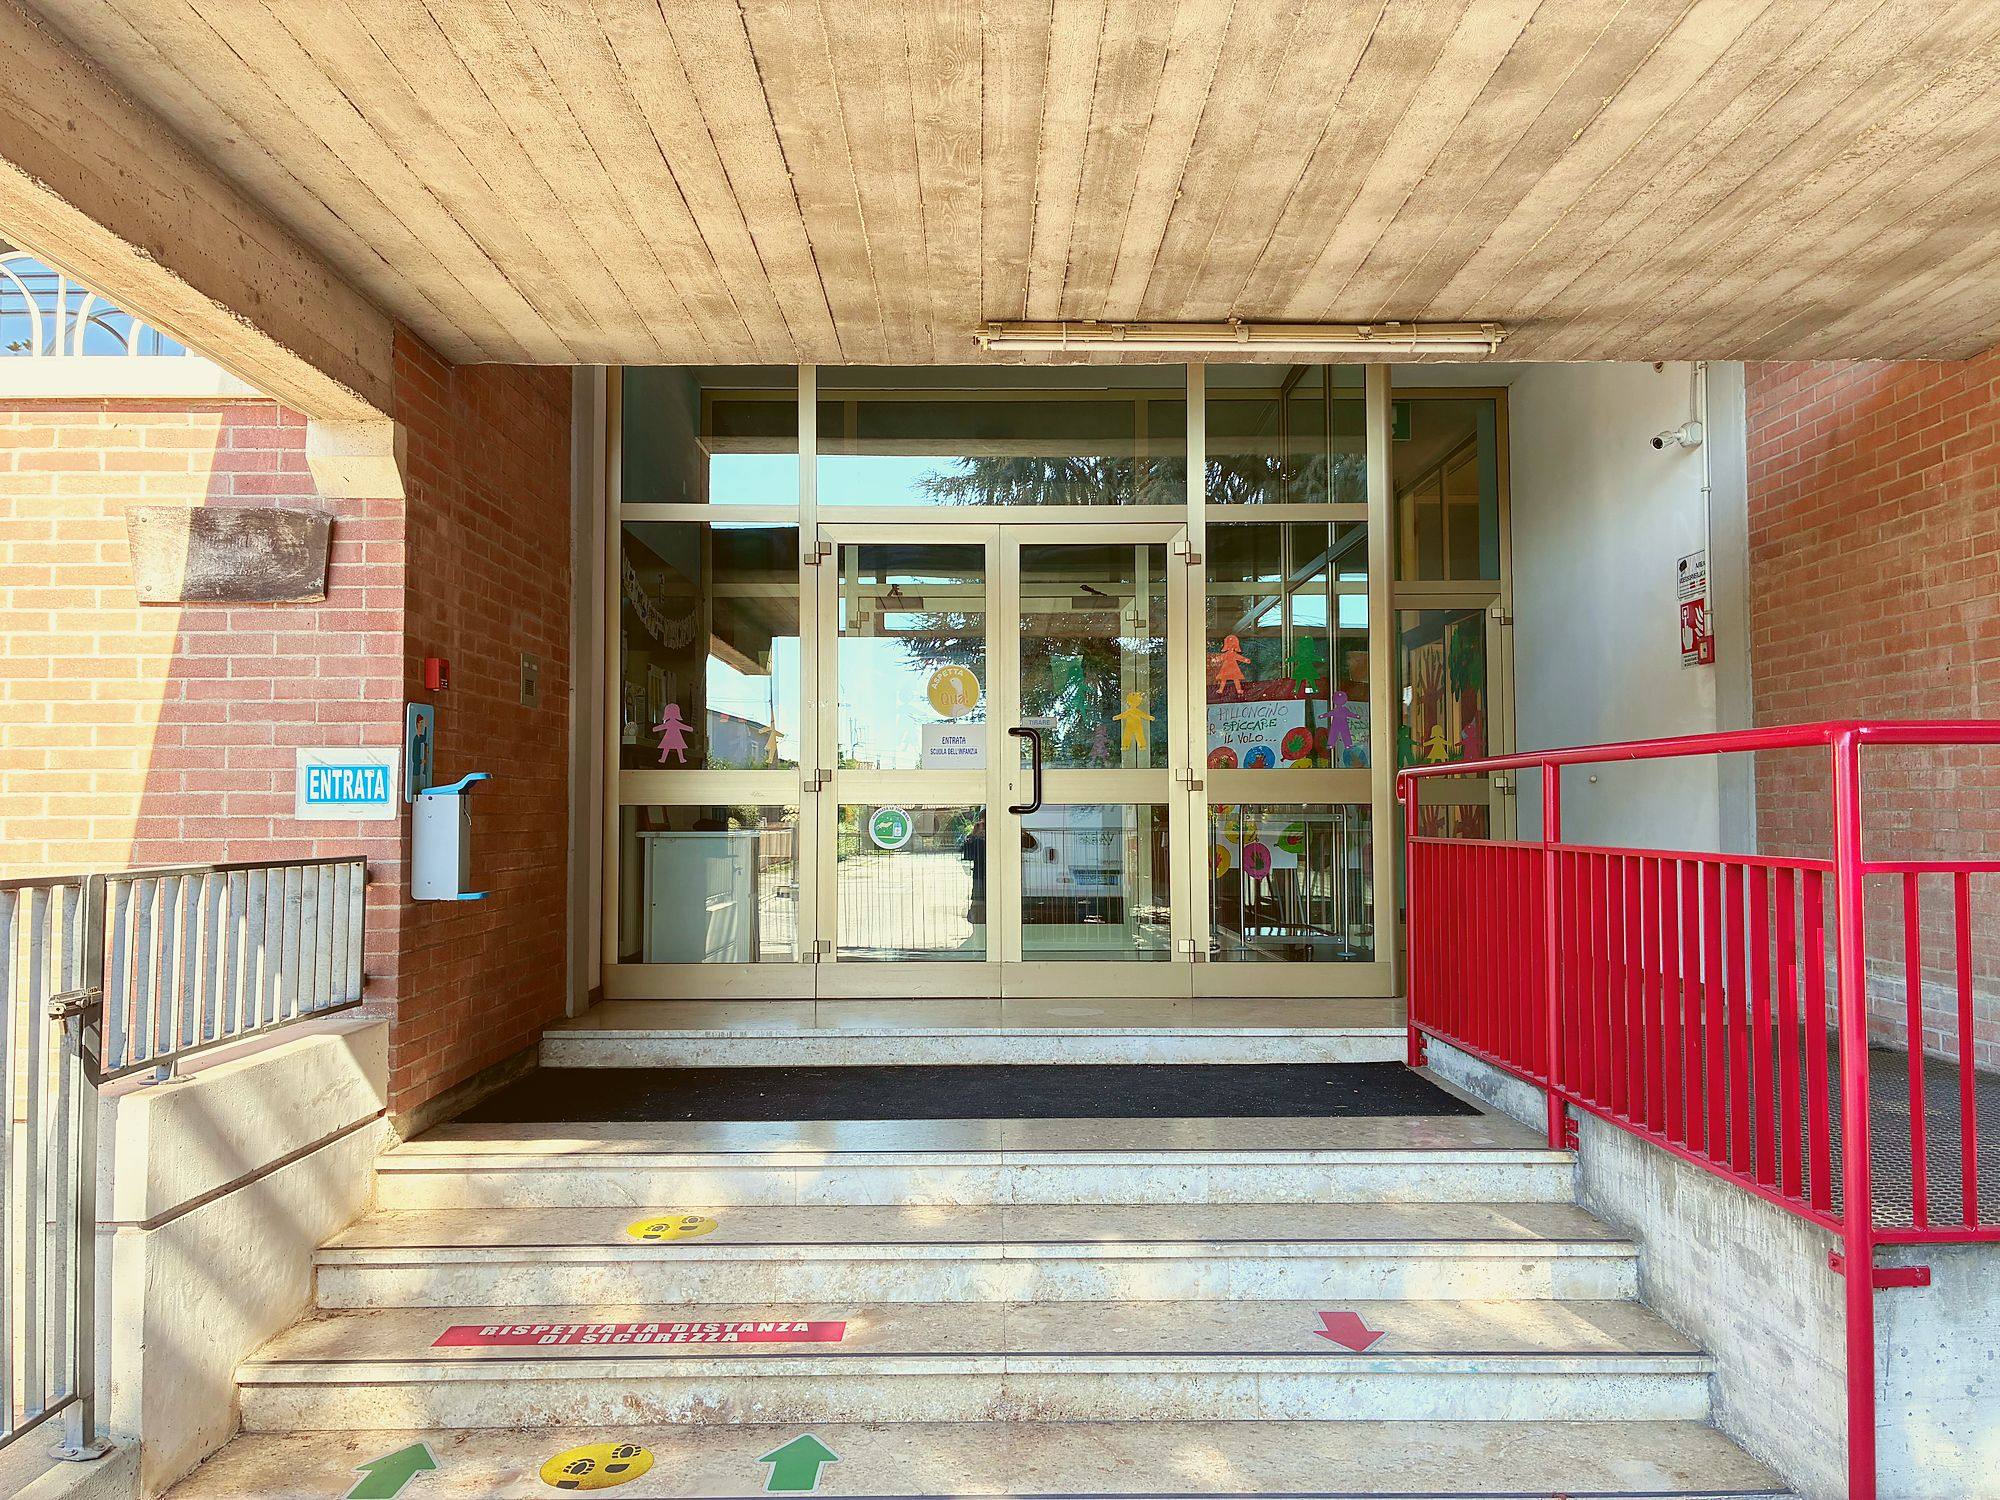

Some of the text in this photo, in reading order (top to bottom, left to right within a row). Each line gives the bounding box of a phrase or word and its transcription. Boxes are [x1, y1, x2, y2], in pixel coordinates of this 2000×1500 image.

[932, 668, 964, 690] ASPETTA
[942, 736, 966, 745] ENTRATA
[309, 768, 386, 800] ENTRATA
[478, 1322, 809, 1336] RISPETTA LA DISTANZA
[537, 1332, 738, 1344] DI SICUREZZA
